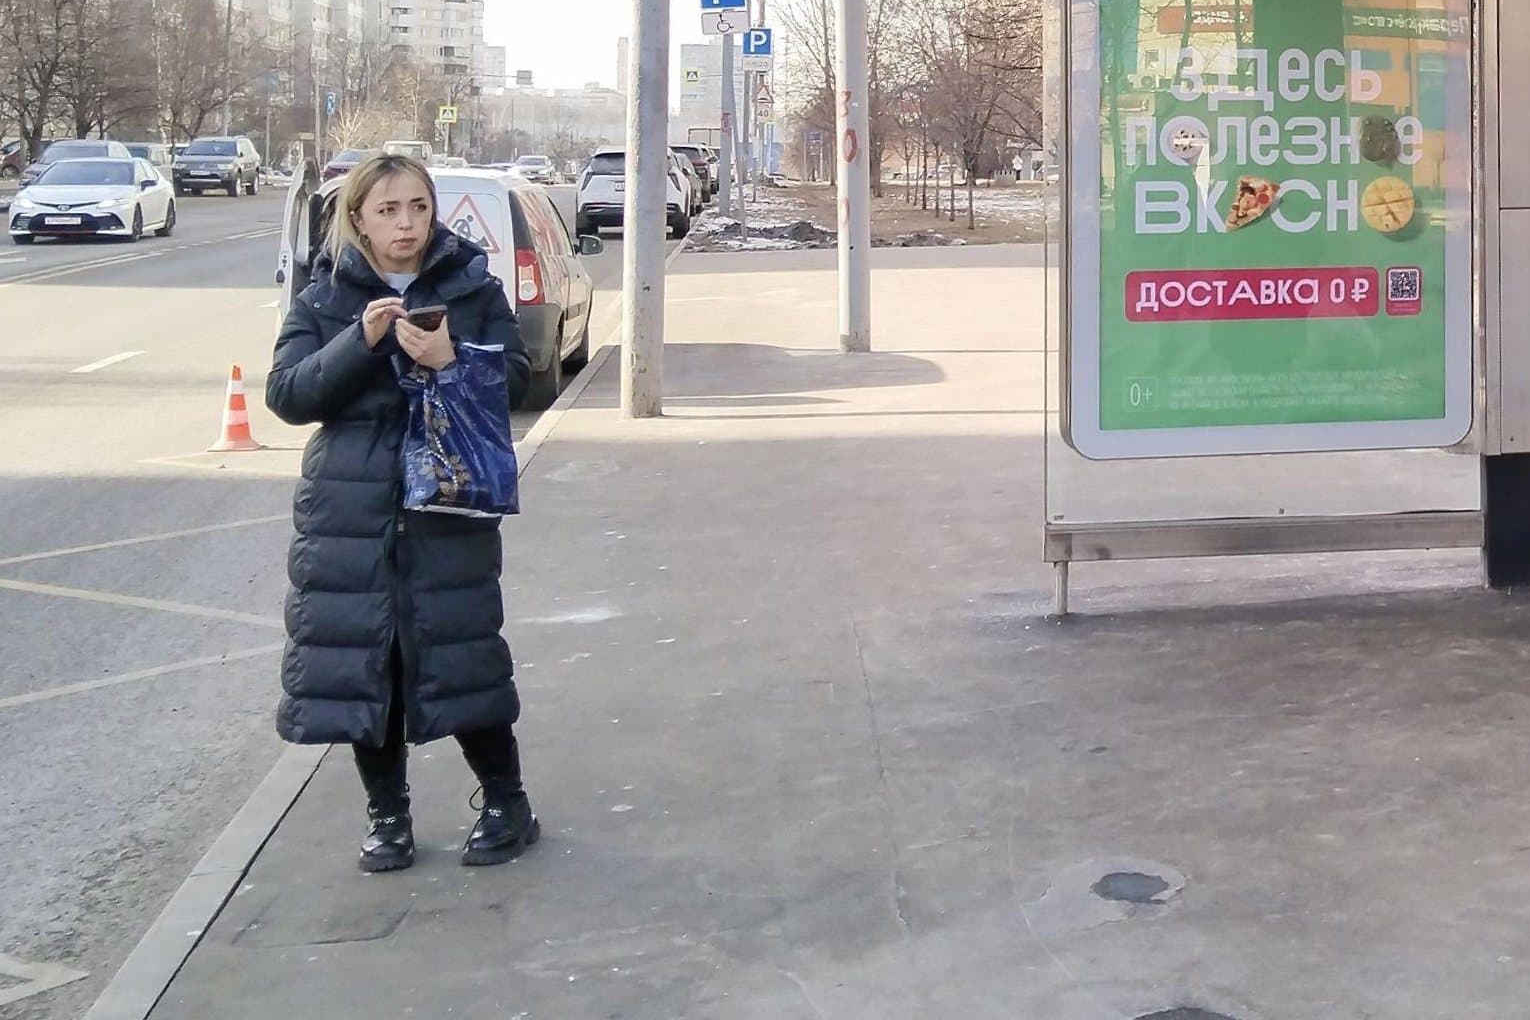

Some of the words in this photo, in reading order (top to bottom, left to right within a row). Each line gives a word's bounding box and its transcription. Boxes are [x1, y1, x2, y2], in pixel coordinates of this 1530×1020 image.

[750, 30, 768, 53] P
[1125, 115, 1424, 166] полезне
[1135, 175, 1416, 235] ВКСН
[1129, 382, 1153, 407] 0+
